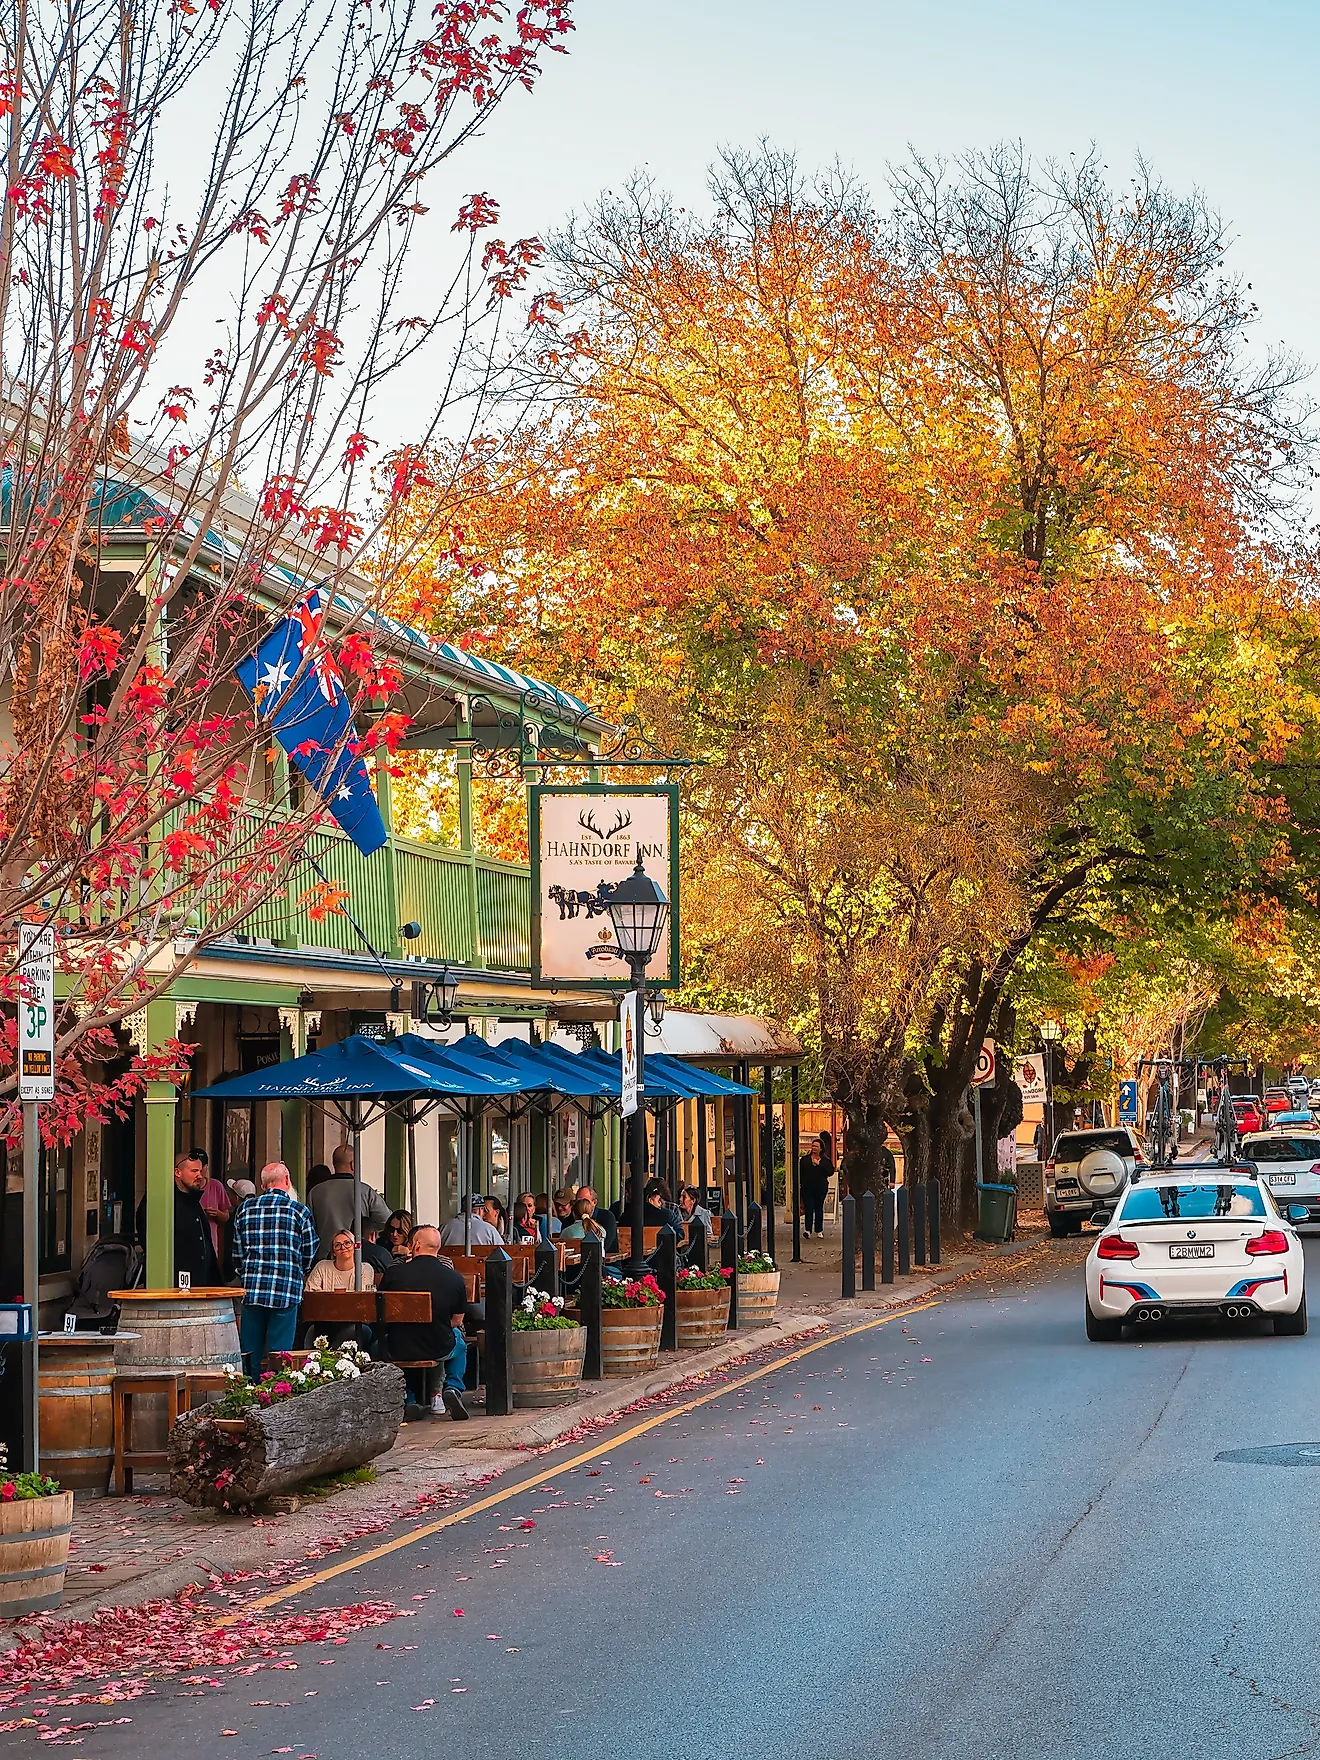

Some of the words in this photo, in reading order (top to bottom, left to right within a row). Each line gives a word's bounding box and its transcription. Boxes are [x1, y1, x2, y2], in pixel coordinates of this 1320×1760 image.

[547, 841, 630, 857] HAHNDORF
[636, 841, 663, 858] INN
[39, 934, 51, 946] ARE
[23, 967, 50, 982] PARKING
[26, 1006, 47, 1038] 3P
[977, 1056, 988, 1071] 0
[1176, 1247, 1212, 1257] 2BMWM2
[180, 1274, 189, 1286] 90
